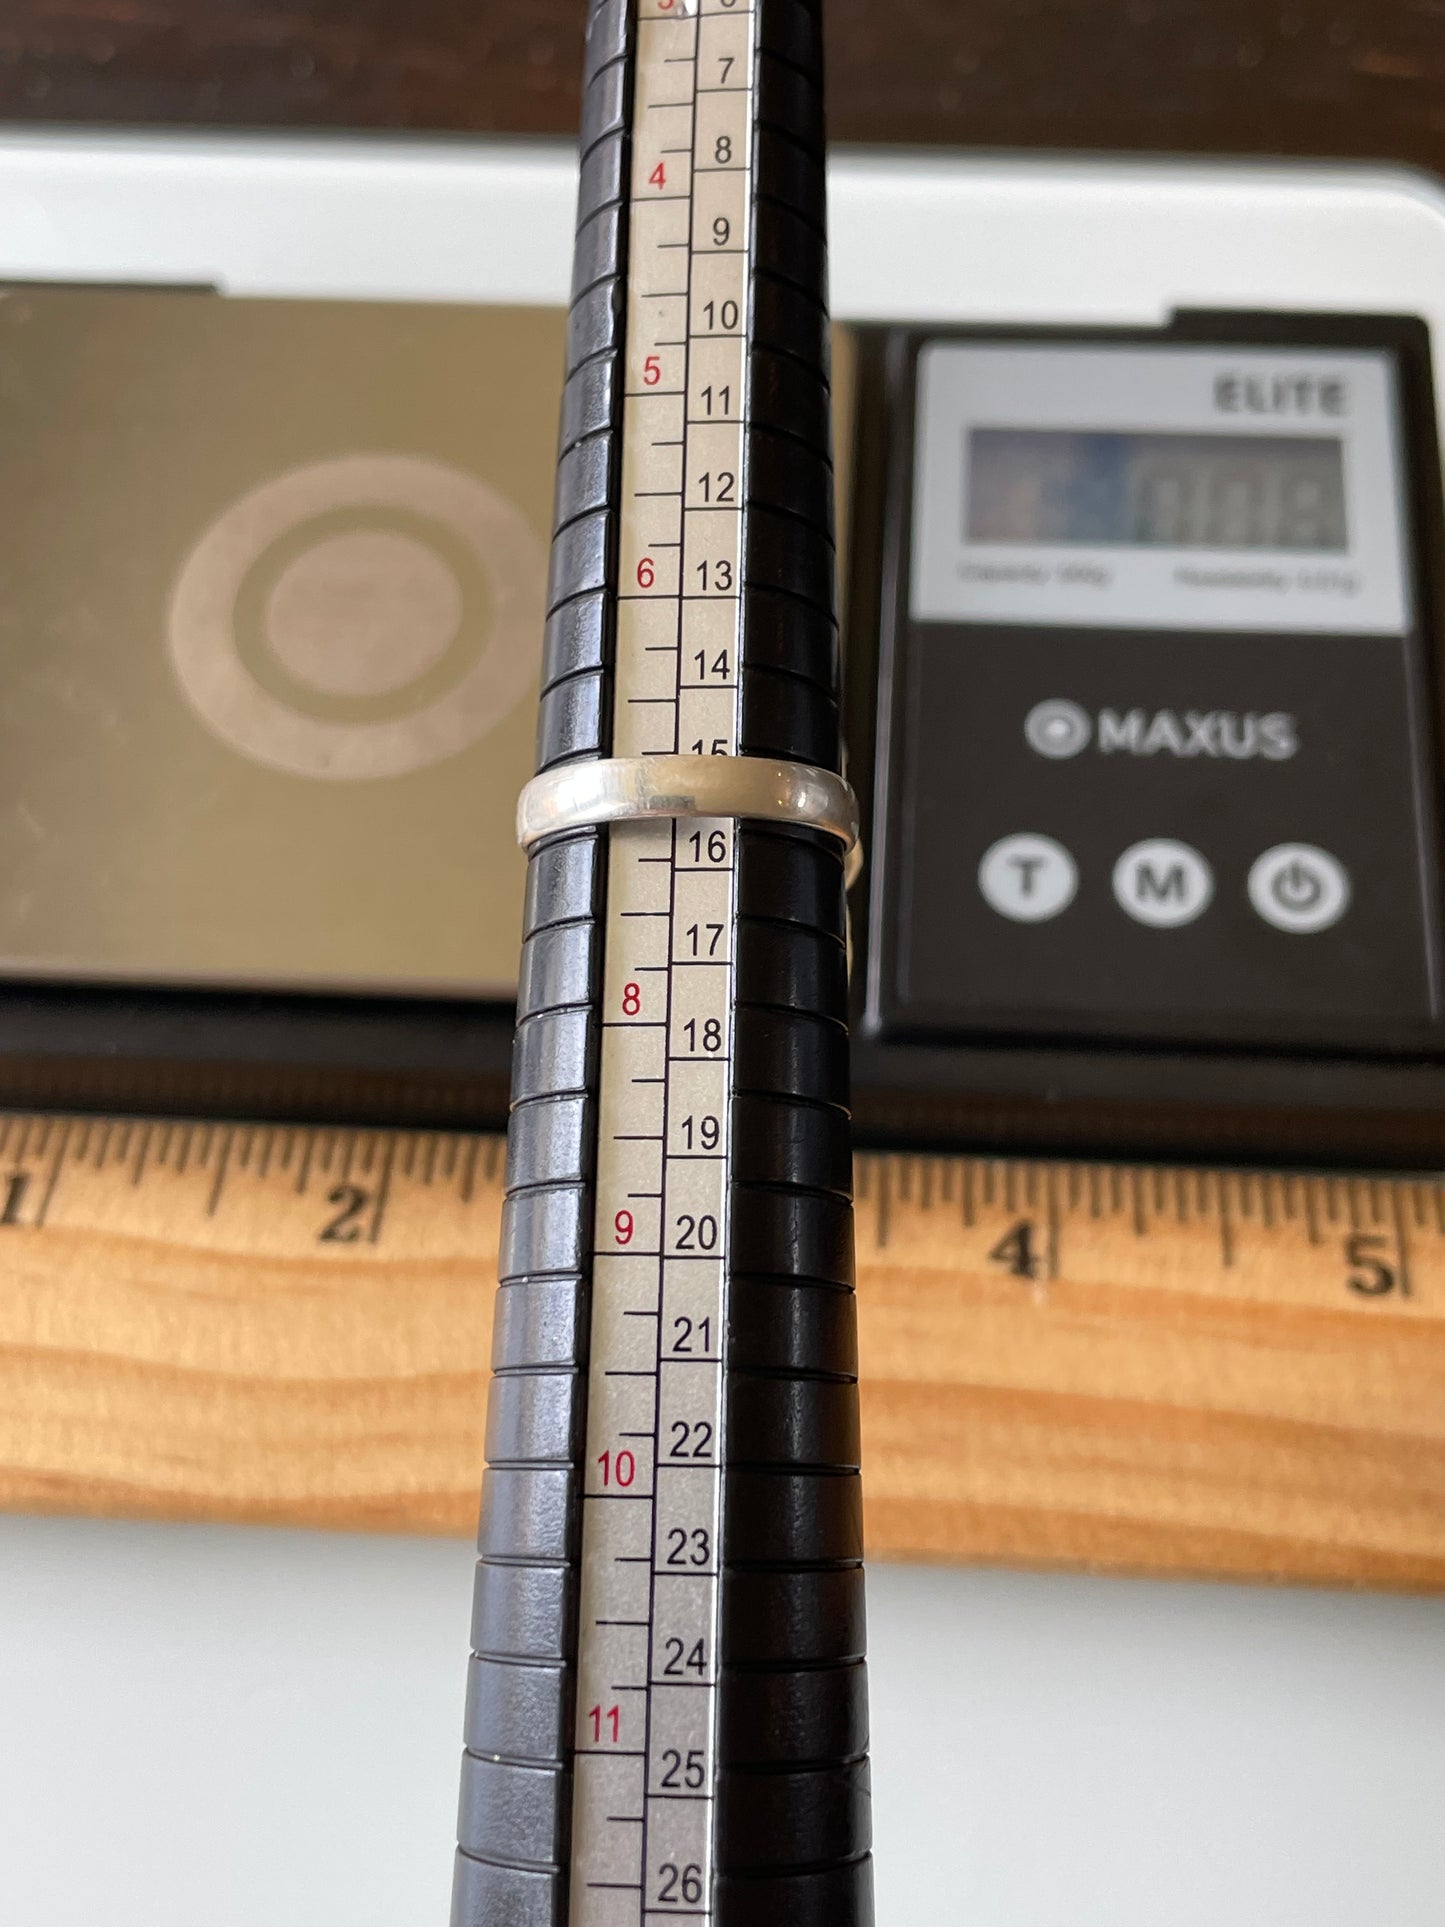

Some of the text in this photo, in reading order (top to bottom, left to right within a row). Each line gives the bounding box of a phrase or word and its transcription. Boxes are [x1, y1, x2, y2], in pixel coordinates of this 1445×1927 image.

[718, 57, 735, 84] 7
[714, 136, 732, 164] 8
[649, 162, 666, 190] 4
[712, 217, 730, 246] 9
[704, 300, 738, 331] 10
[644, 355, 661, 385] 5
[702, 385, 730, 416] 11
[1213, 372, 1350, 417] ELITE
[699, 471, 735, 503] 12
[636, 557, 655, 589] 6
[697, 559, 733, 592] 13
[694, 649, 731, 681] 14
[1098, 708, 1299, 760] MAXUS
[688, 830, 727, 863] 16
[1007, 855, 1047, 899] T
[1134, 861, 1189, 905] M
[686, 923, 725, 957] 17
[622, 982, 641, 1017] 8
[683, 1017, 722, 1053] 18
[681, 1115, 720, 1151] 19
[318, 1184, 369, 1243] 2
[614, 1209, 634, 1246] 9
[675, 1214, 718, 1251] 20
[990, 1220, 1042, 1280] 4
[1345, 1233, 1396, 1297] 5
[672, 1316, 710, 1353] 21
[669, 1420, 713, 1458] 22
[597, 1450, 635, 1488] 10
[666, 1527, 710, 1567] 23
[663, 1637, 708, 1676] 24
[588, 1705, 620, 1743] 11
[660, 1749, 705, 1789] 25
[657, 1862, 702, 1904] 26
